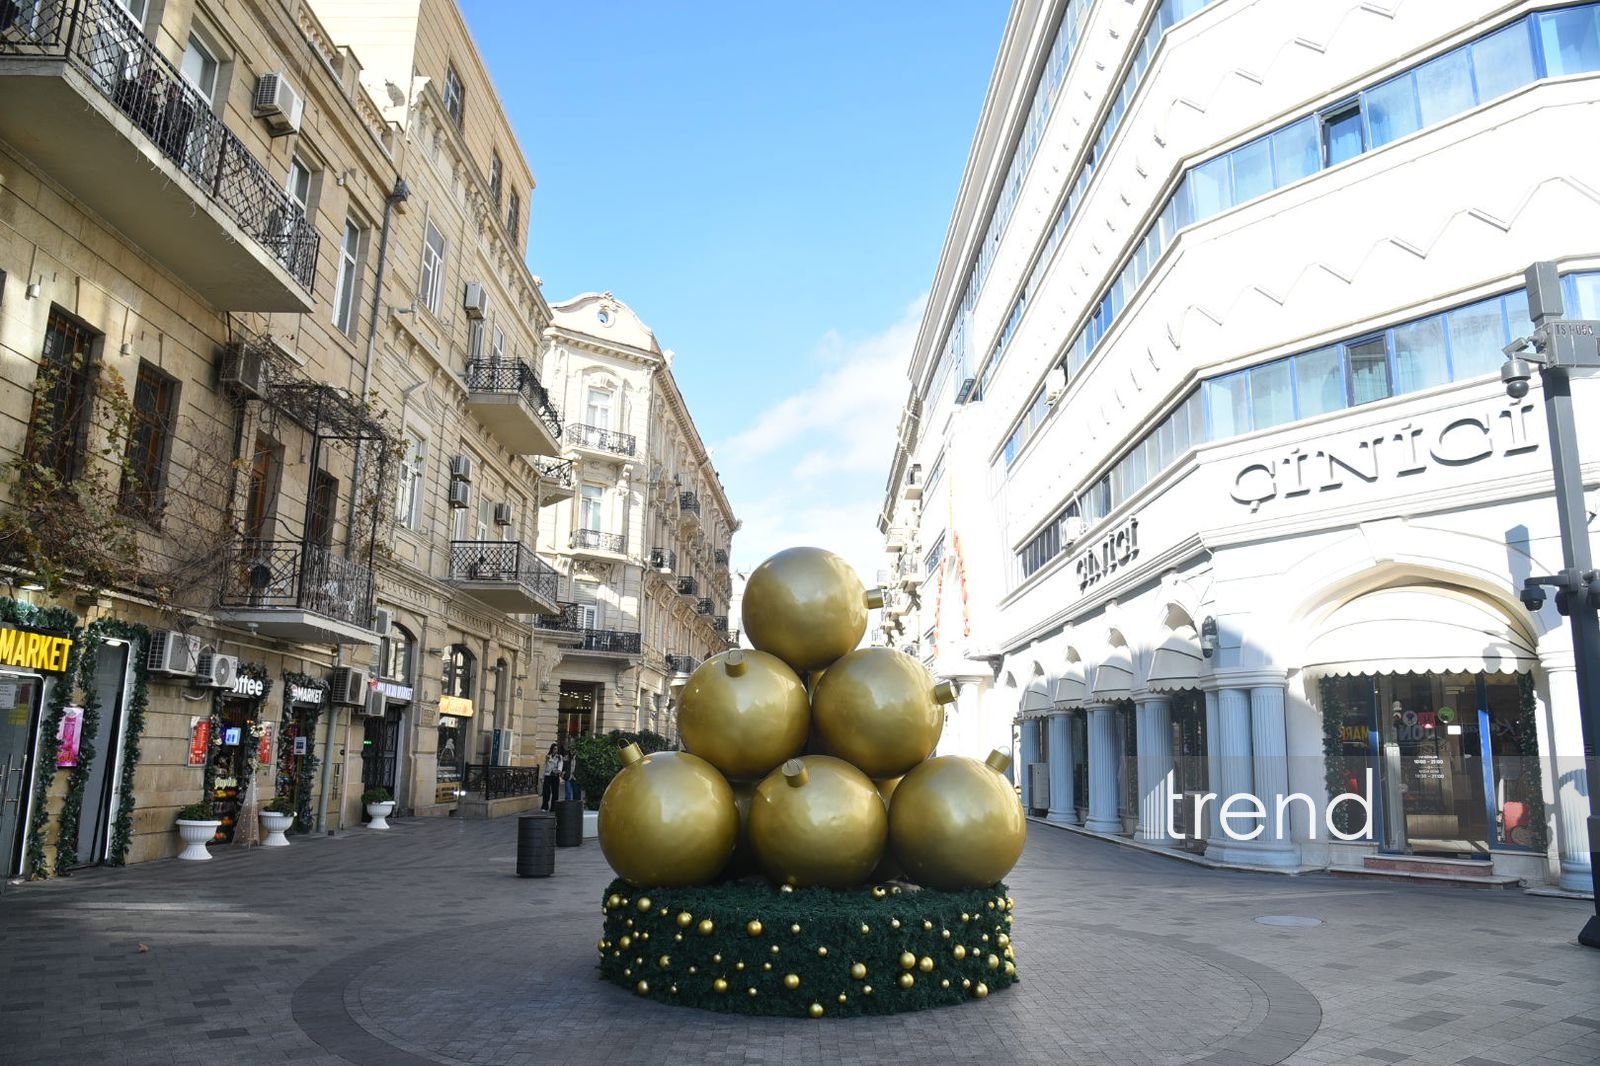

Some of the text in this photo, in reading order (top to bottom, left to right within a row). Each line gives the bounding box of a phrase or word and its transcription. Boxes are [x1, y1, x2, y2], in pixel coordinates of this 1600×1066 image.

[1230, 399, 1539, 513] ÇİNİCİ
[1076, 517, 1140, 595] ÇİNİCİ
[0, 627, 73, 673] MARKET
[215, 675, 263, 696] offee
[297, 687, 323, 703] MARKET
